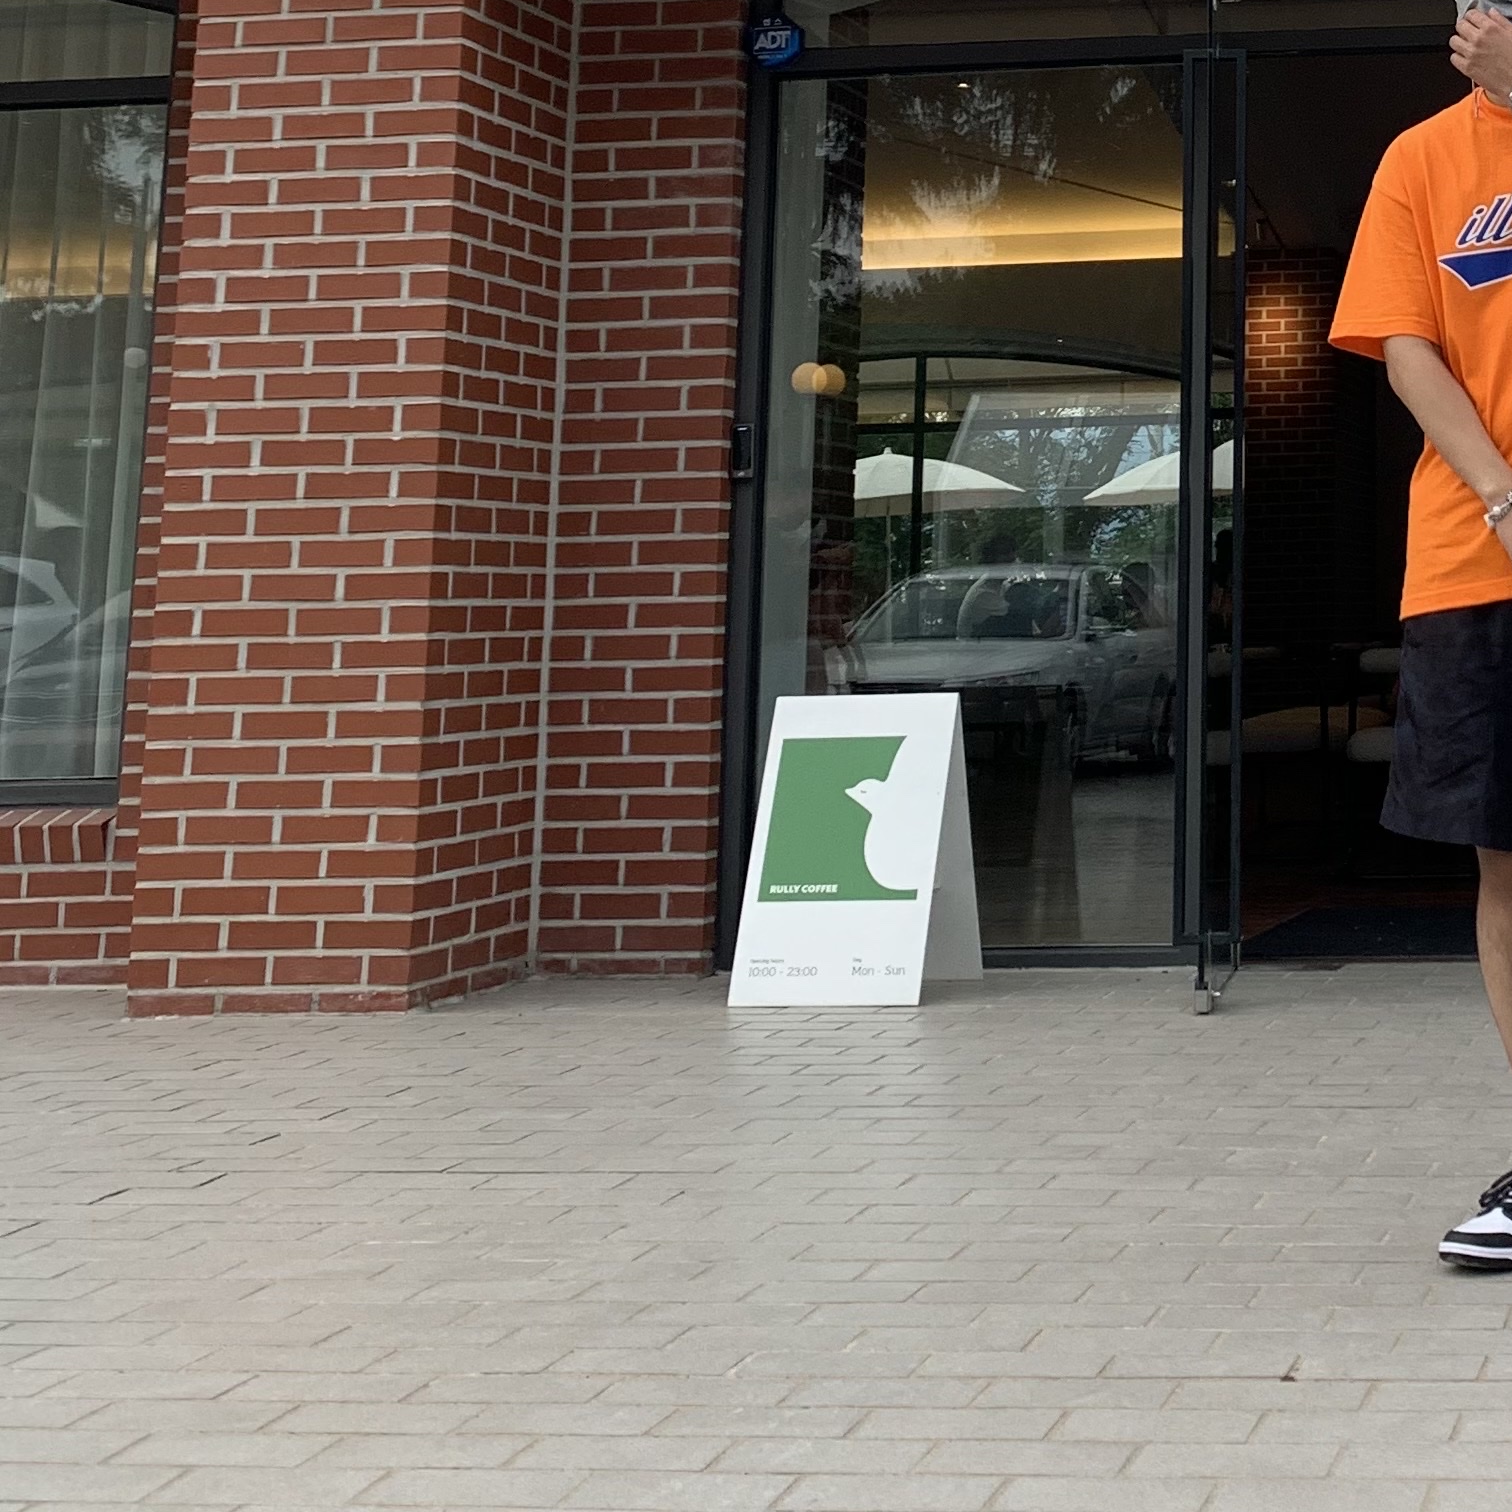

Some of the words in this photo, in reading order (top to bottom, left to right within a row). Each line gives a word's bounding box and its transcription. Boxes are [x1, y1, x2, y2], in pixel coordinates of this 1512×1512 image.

[753, 31, 791, 49] ADT
[769, 884, 801, 894] RULLY
[801, 884, 838, 894] COFFEE
[748, 966, 777, 977] 10:00
[786, 966, 818, 977] 23:00
[851, 966, 874, 976] Mon
[884, 965, 906, 976] Sun
